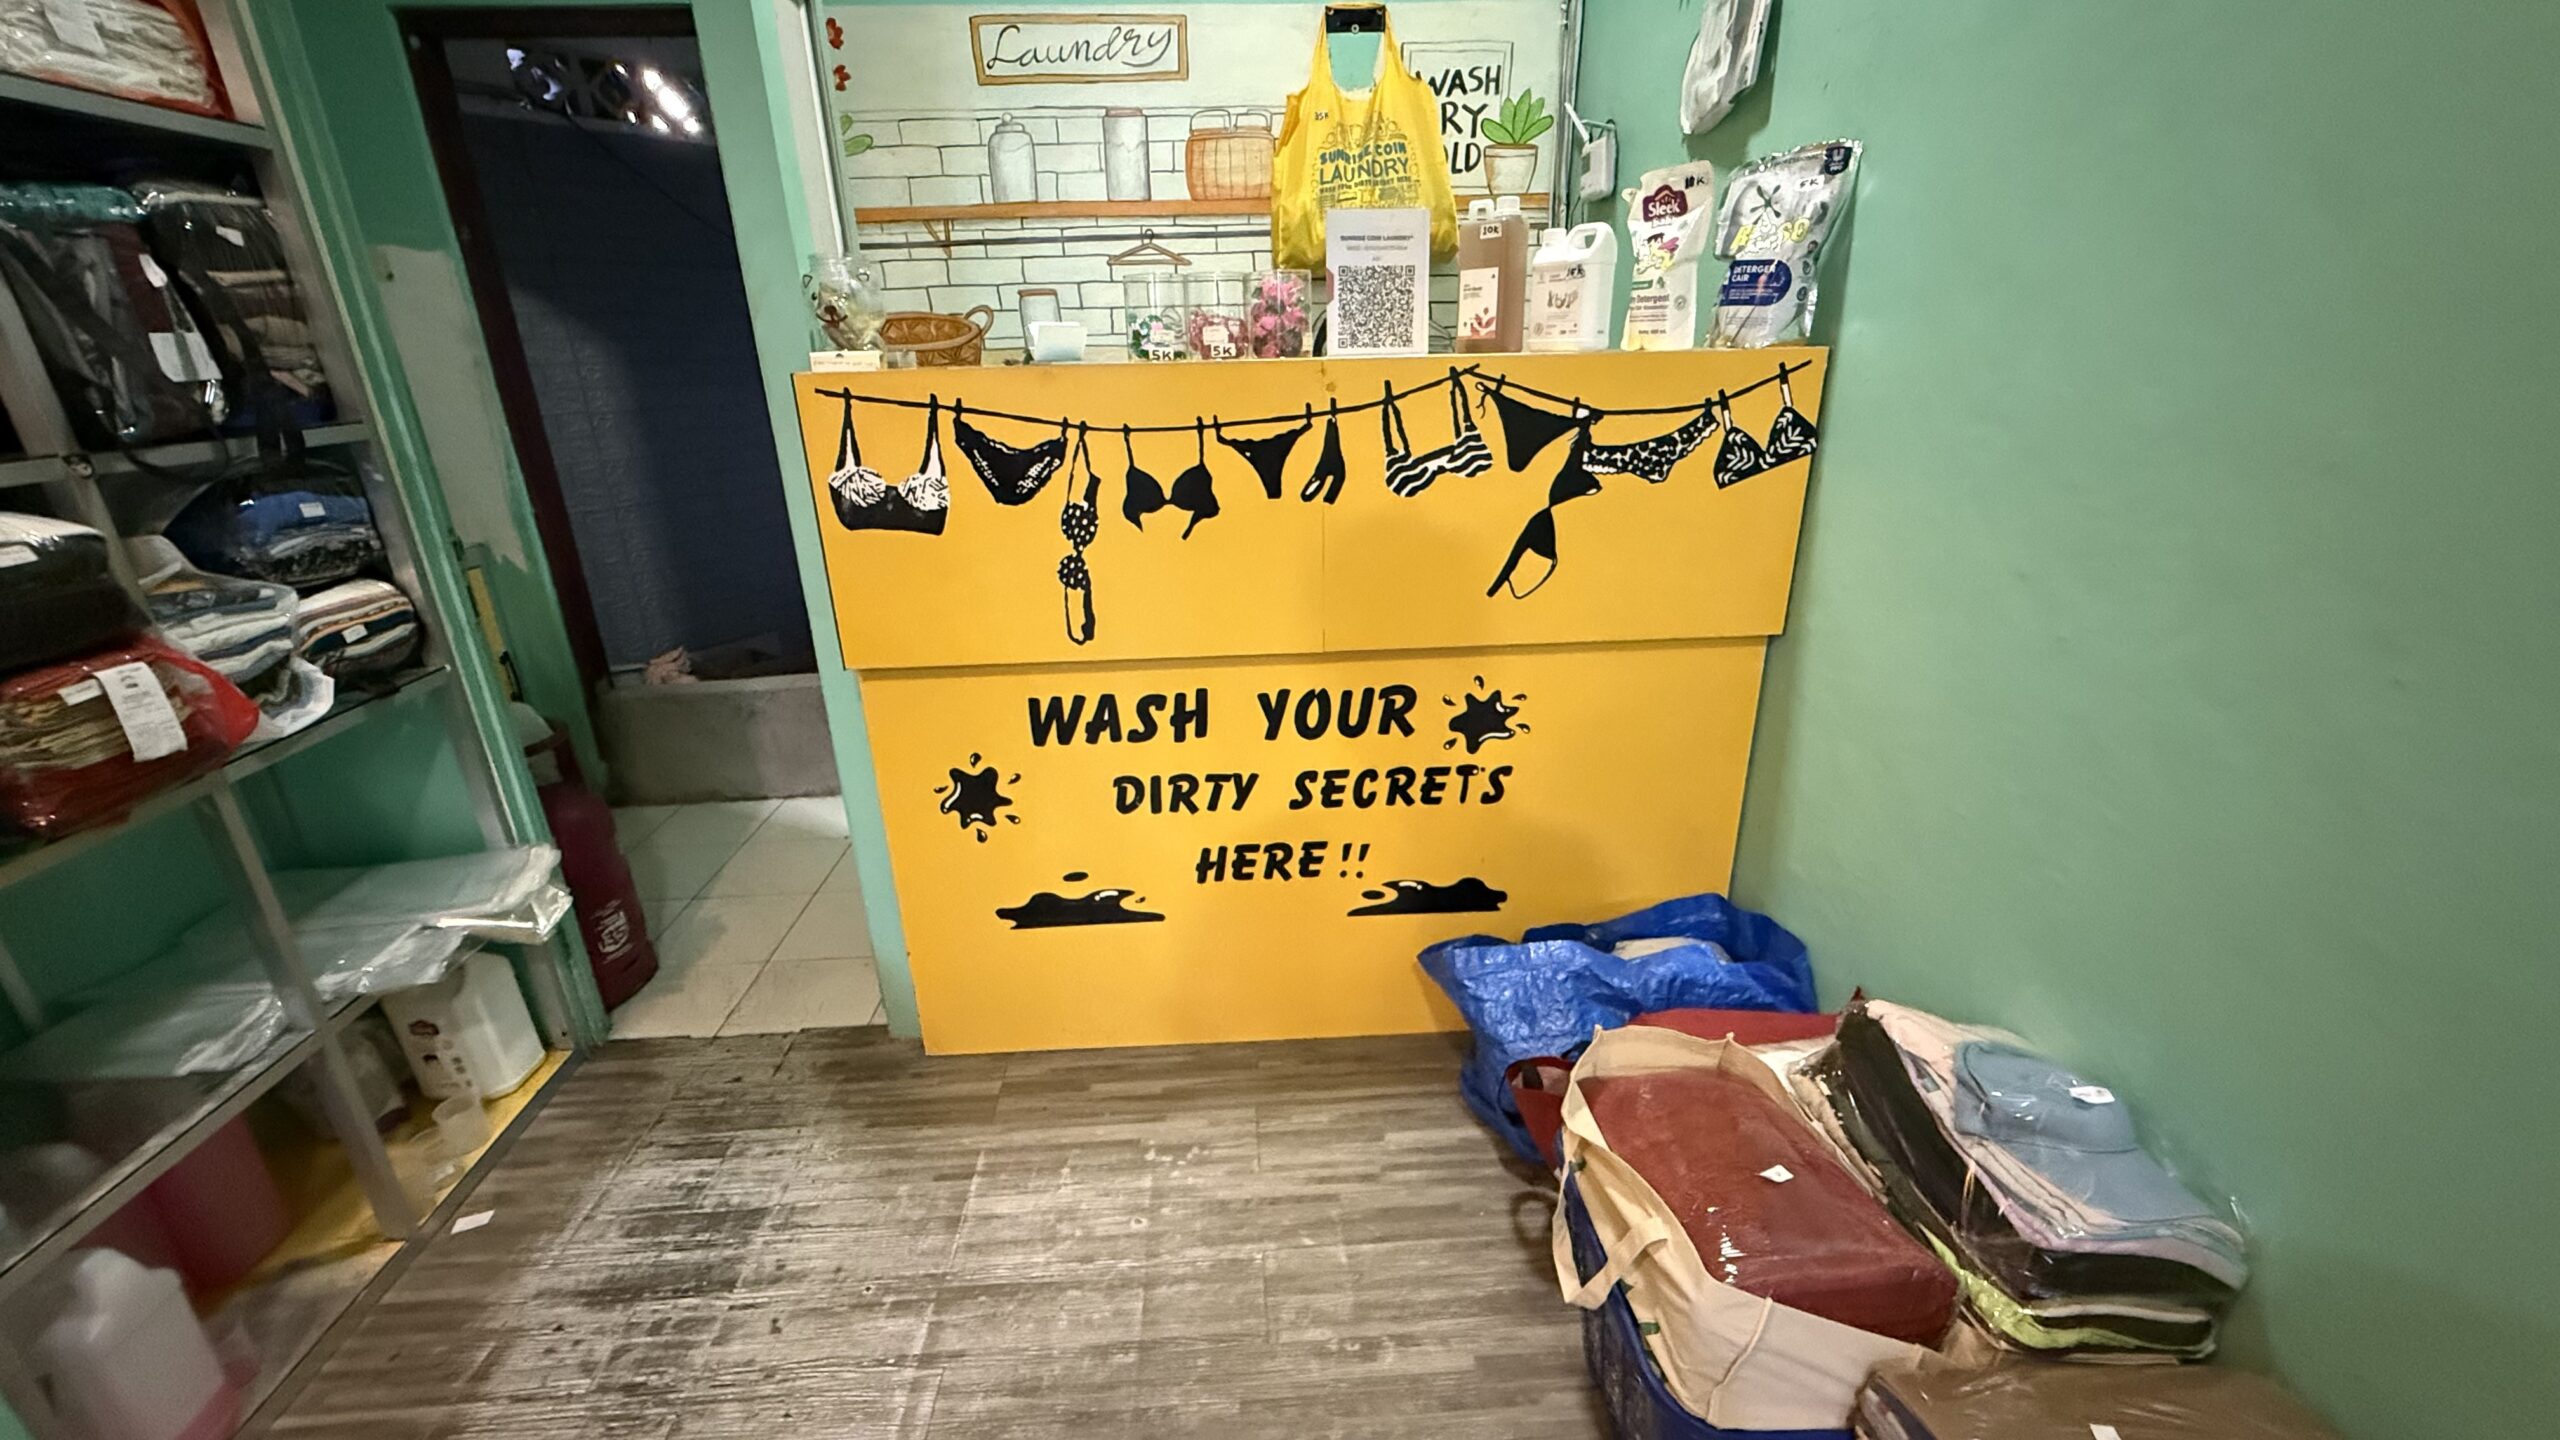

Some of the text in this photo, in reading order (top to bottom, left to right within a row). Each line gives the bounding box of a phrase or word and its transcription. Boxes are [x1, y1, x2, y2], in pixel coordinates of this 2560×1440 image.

[986, 25, 1171, 70] Laundry
[1416, 65, 1502, 97] WASH
[1441, 101, 1488, 138] RY
[1319, 141, 1407, 165] SUNRISE COIN
[1319, 156, 1409, 186] LAUNDRY
[1648, 199, 1680, 218] Sleek
[1731, 274, 1750, 282] CAIR
[1152, 349, 1171, 360] 5K
[1213, 346, 1233, 356] 5K
[1027, 684, 1418, 747] WASH YOUR
[1112, 764, 1513, 815] DIRTY SECRETS
